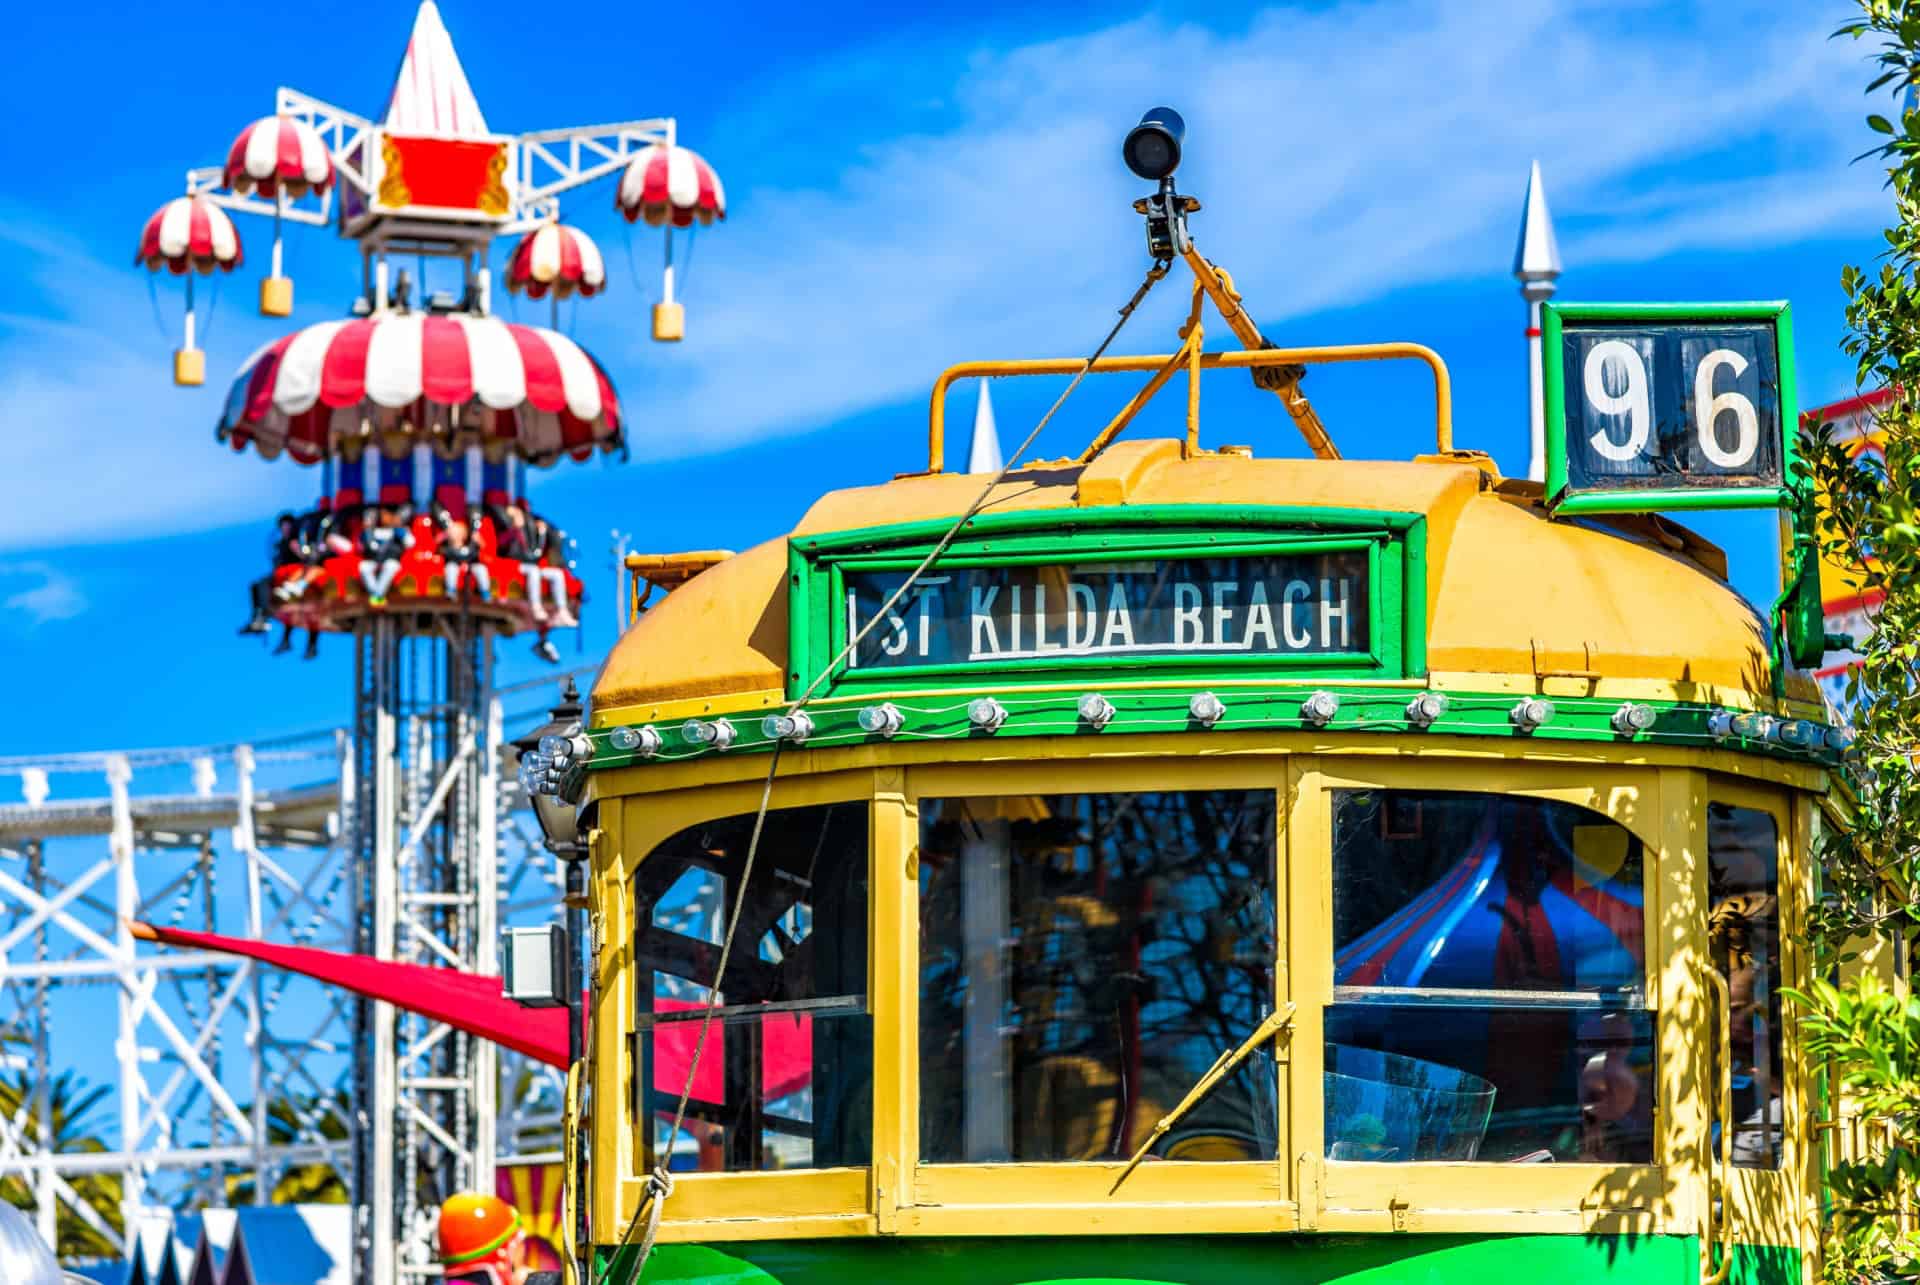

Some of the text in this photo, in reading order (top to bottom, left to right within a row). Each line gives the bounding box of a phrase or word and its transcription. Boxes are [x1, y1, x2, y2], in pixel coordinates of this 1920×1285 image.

[1584, 340, 1759, 468] 96
[881, 579, 1349, 656] ST KILDA BEACH
